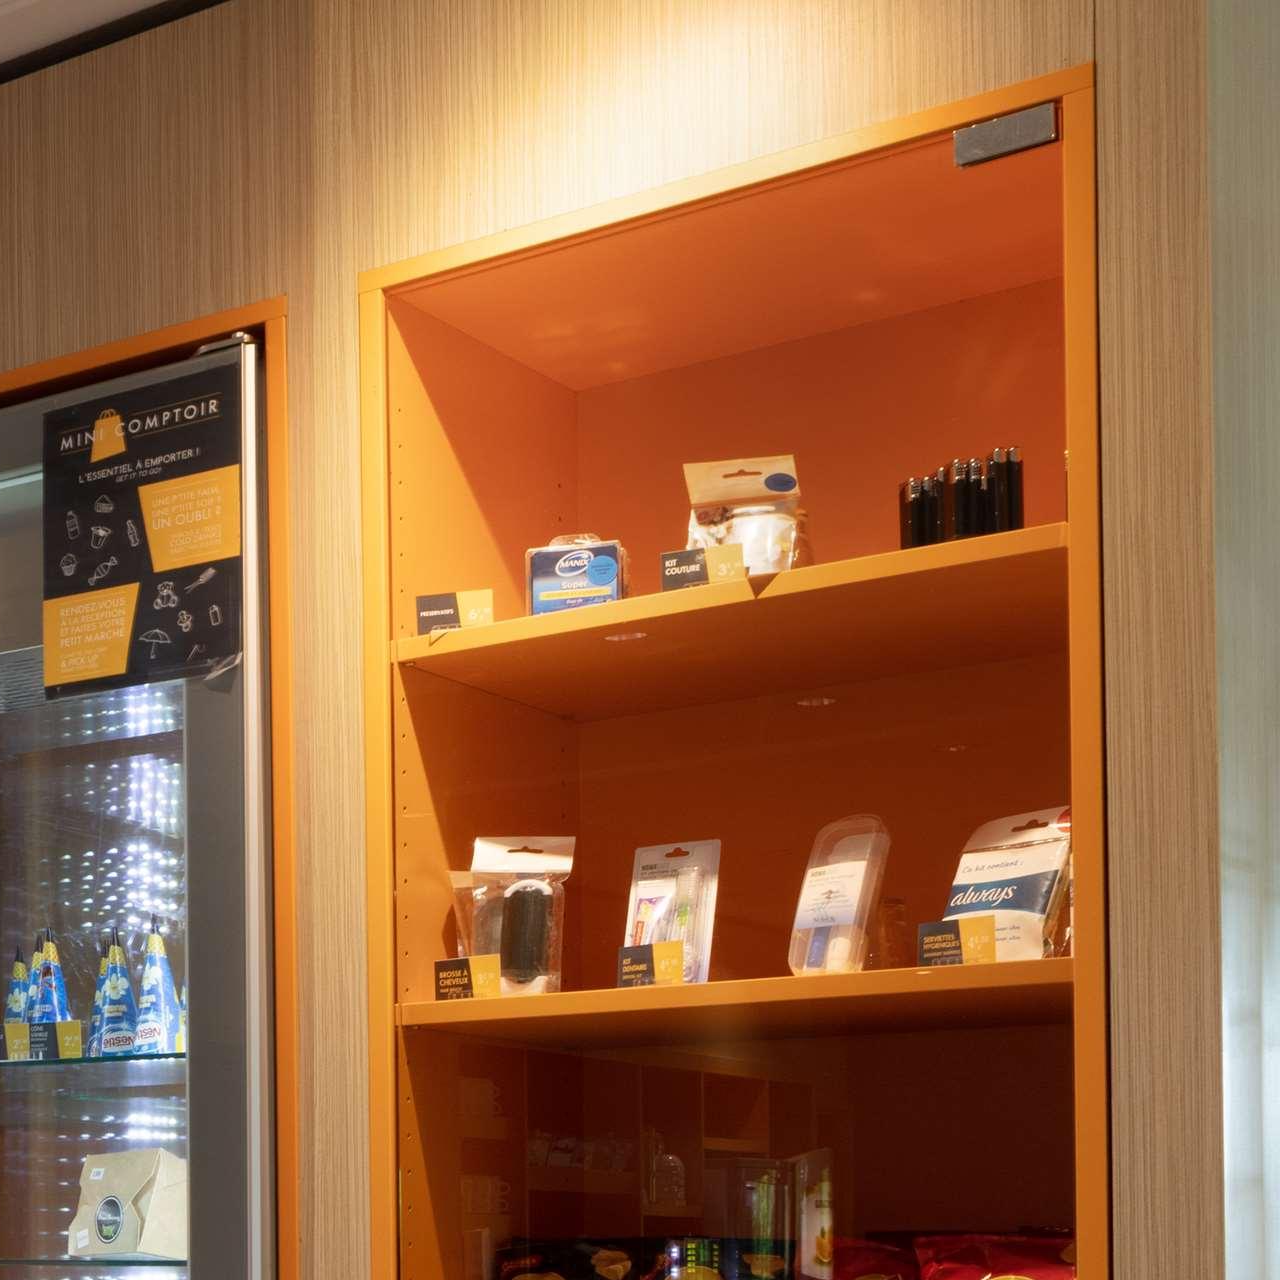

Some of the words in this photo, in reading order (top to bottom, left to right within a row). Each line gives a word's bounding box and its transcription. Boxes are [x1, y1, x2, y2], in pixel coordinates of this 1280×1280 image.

[59, 428, 104, 452] MINI
[114, 399, 220, 437] COMPTOIR
[78, 463, 134, 483] L'ESSENTIEL
[144, 448, 194, 470] EMPORTER
[664, 558, 678, 568] KIT
[664, 563, 701, 577] COUTURE
[950, 885, 1018, 907] always
